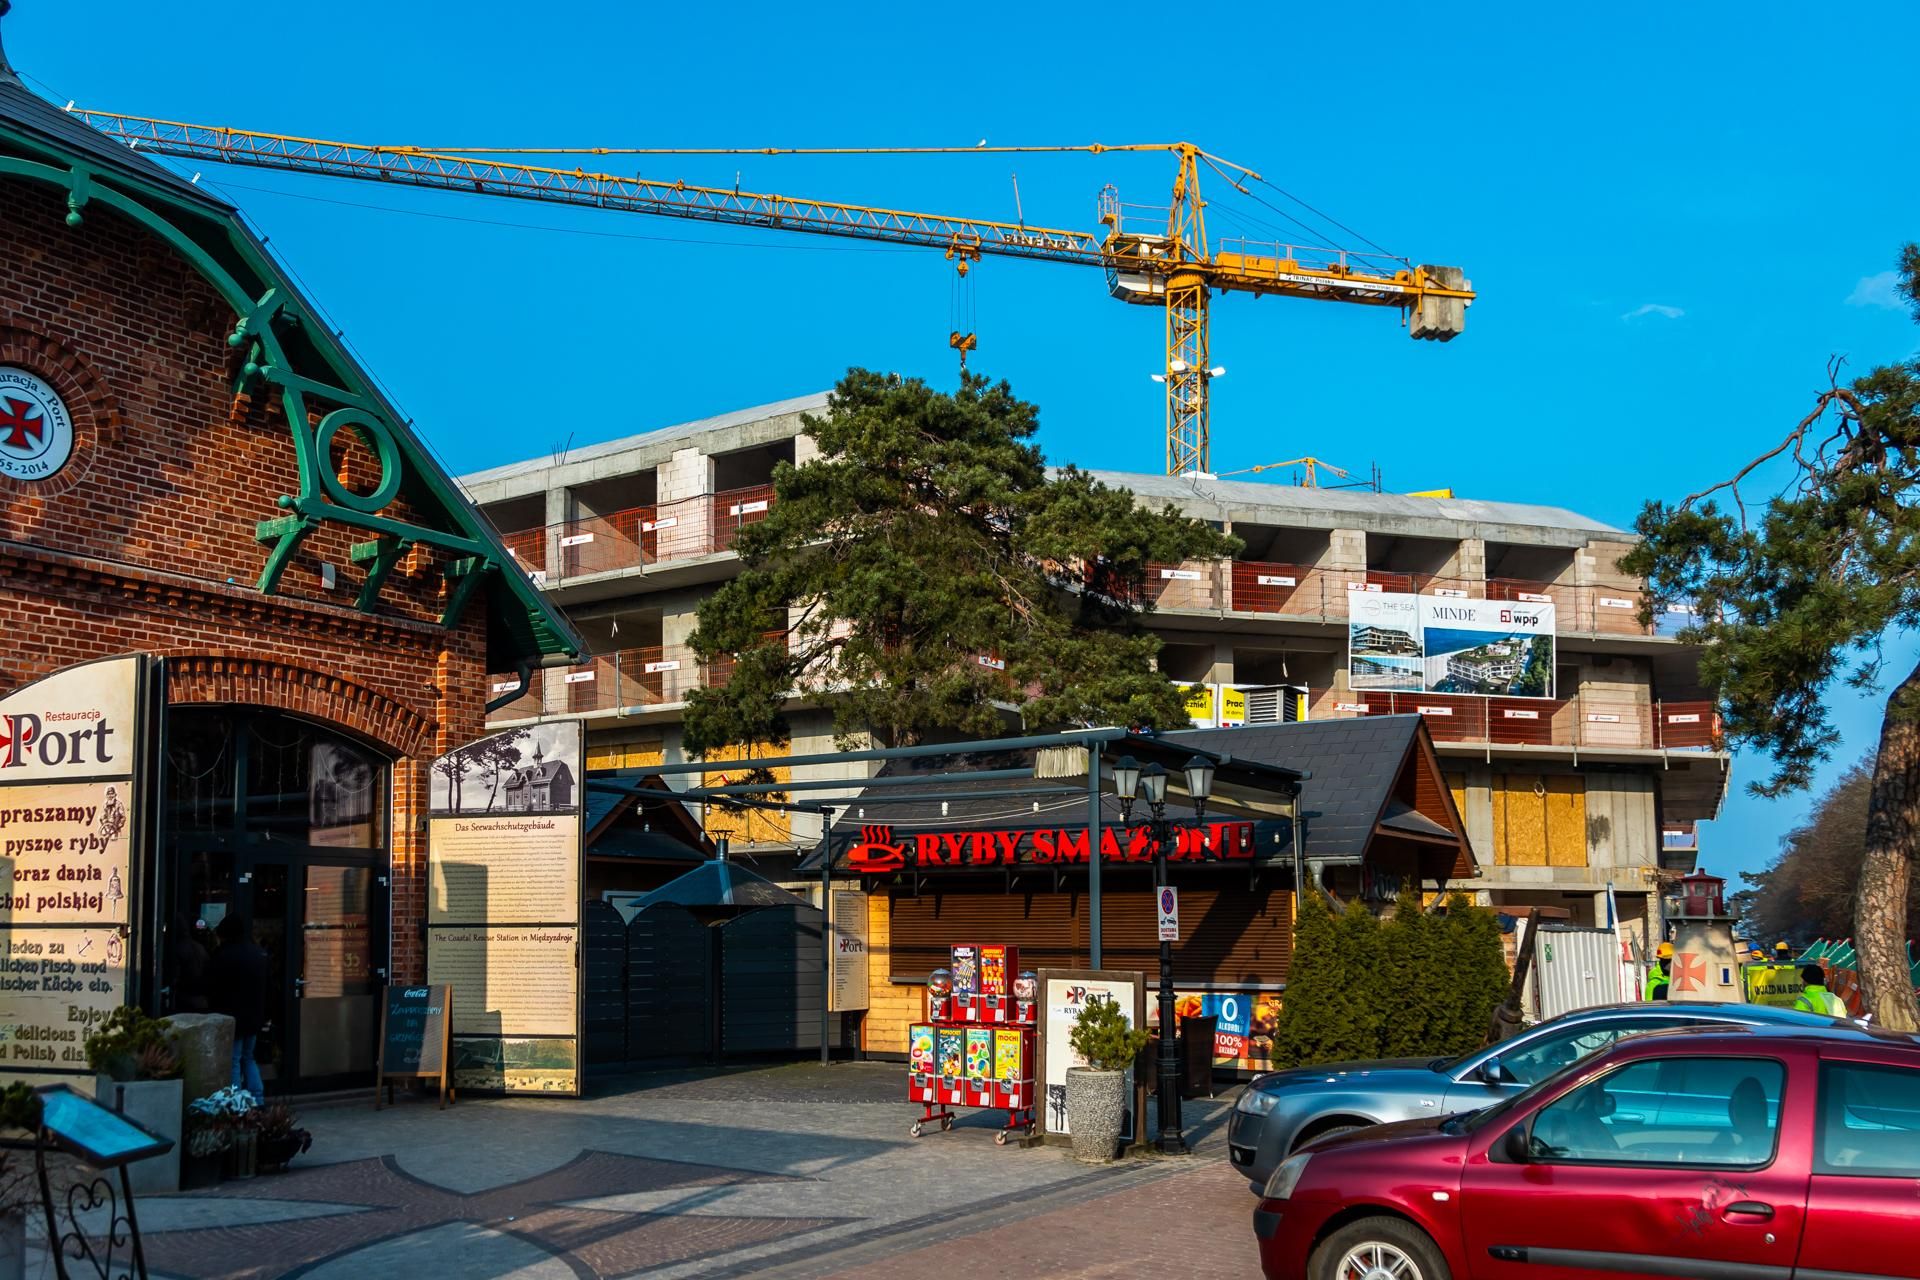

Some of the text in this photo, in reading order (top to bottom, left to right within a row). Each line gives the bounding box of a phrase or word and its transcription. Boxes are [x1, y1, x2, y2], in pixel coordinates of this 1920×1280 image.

[46, 395, 66, 428] Port
[1383, 602, 1398, 610] THE
[1432, 607, 1476, 621] MINDE
[1513, 615, 1539, 627] wpip
[45, 709, 101, 722] Restauracja
[9, 713, 114, 768] Port
[455, 823, 469, 832] Das
[5, 833, 109, 856] pyszne ryby
[916, 831, 1024, 867] RYBY
[13, 864, 102, 883] oraz dania
[36, 891, 103, 913] polskiej
[435, 934, 446, 942] The
[473, 934, 495, 942] Rescue
[496, 934, 519, 942] Station
[842, 938, 863, 953] Port
[49, 943, 64, 954] zu
[81, 959, 107, 975] und
[1073, 986, 1114, 1005] Port
[15, 1024, 76, 1041] delicious
[1215, 1034, 1243, 1048] 100%
[13, 1044, 56, 1063] Polish
